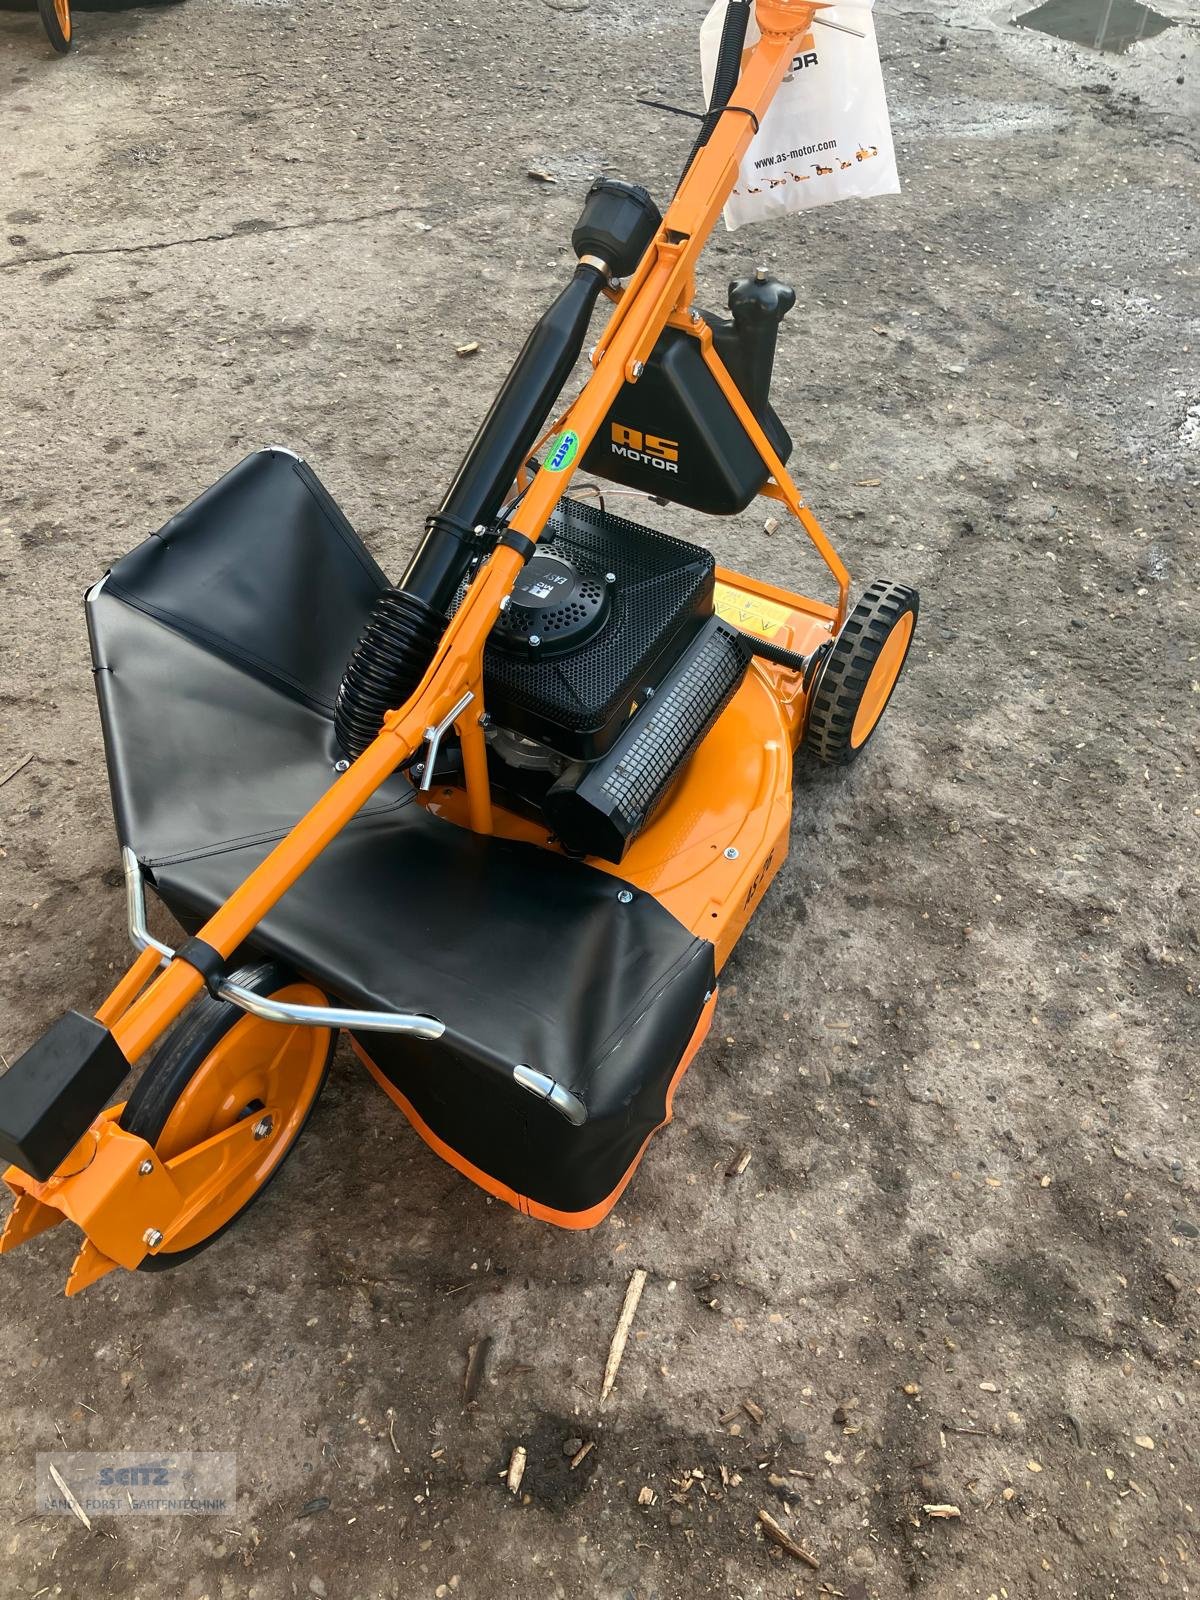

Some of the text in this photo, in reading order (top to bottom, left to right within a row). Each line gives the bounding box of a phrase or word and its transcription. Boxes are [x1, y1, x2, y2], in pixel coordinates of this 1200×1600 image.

[754, 139, 837, 169] www.as-motor.com
[551, 436, 573, 467] SEITZ
[611, 422, 678, 462] AS
[612, 443, 678, 473] MOTOR
[543, 572, 568, 584] EASY
